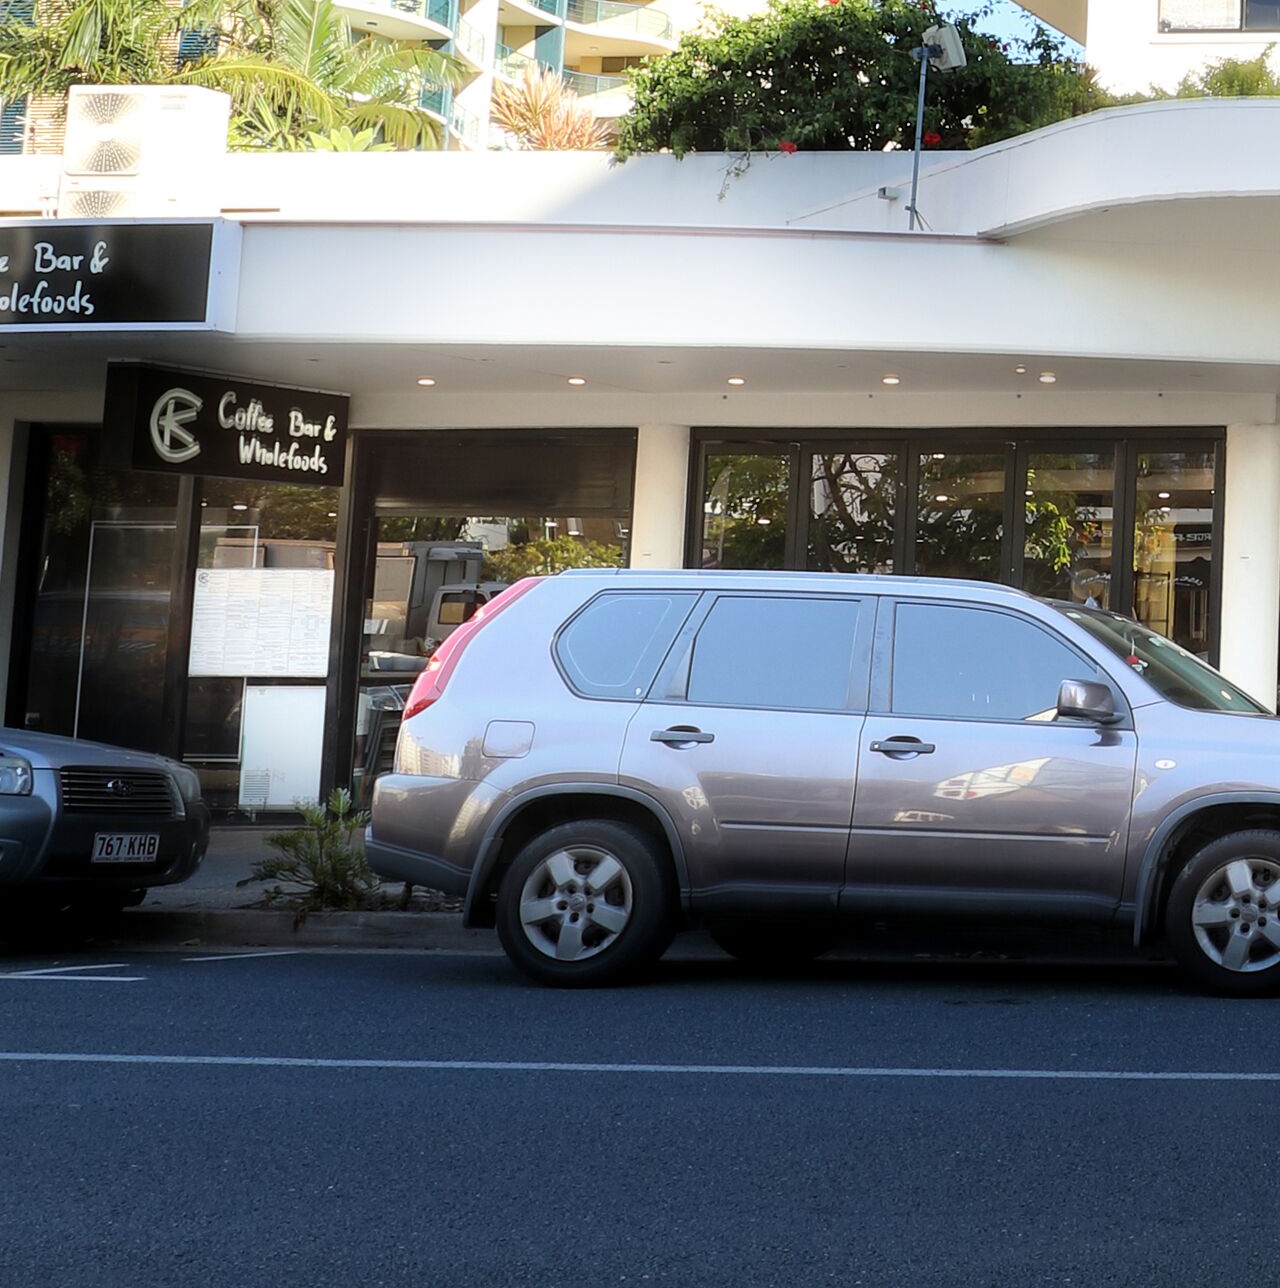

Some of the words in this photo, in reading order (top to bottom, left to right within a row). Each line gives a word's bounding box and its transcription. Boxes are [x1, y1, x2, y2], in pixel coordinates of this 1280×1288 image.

[34, 242, 84, 273] Bar
[90, 241, 109, 273] &
[0, 280, 94, 315] olefoods
[219, 392, 274, 433] Coffee
[289, 407, 321, 438] Bar
[324, 415, 337, 442] &
[239, 433, 328, 474] Wholefoods
